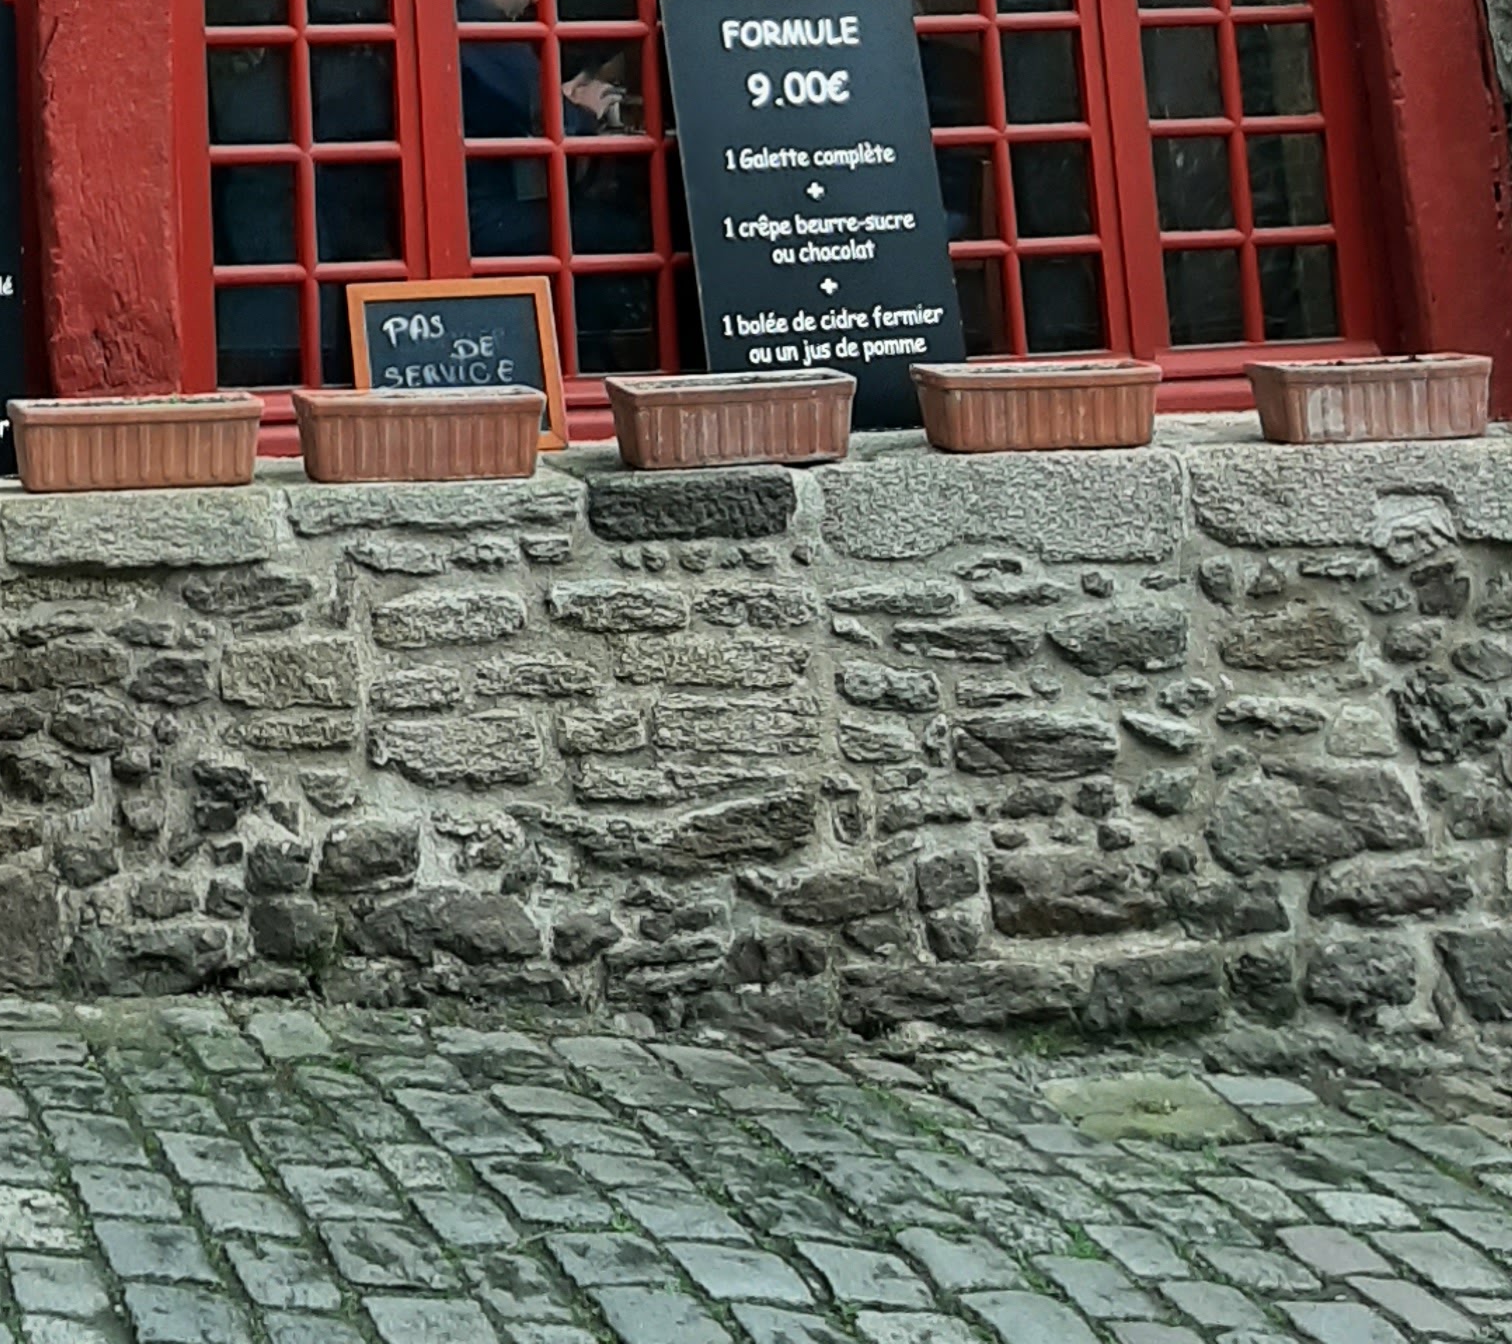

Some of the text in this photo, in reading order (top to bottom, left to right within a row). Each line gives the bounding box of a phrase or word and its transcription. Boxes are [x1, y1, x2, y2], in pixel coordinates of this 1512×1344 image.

[722, 15, 860, 49] FORMULE
[747, 70, 850, 107] 9.00€
[725, 141, 896, 170] 1 Galette complète
[723, 213, 916, 242] 1 crêpe beurre-sucre
[772, 238, 876, 265] ou chocolat
[383, 314, 445, 348] PAS
[722, 303, 944, 336] 1 bolée de cidre fermier
[451, 336, 494, 360] DE
[749, 336, 928, 367] ou un jus de pomme
[384, 359, 514, 388] SERVICE
